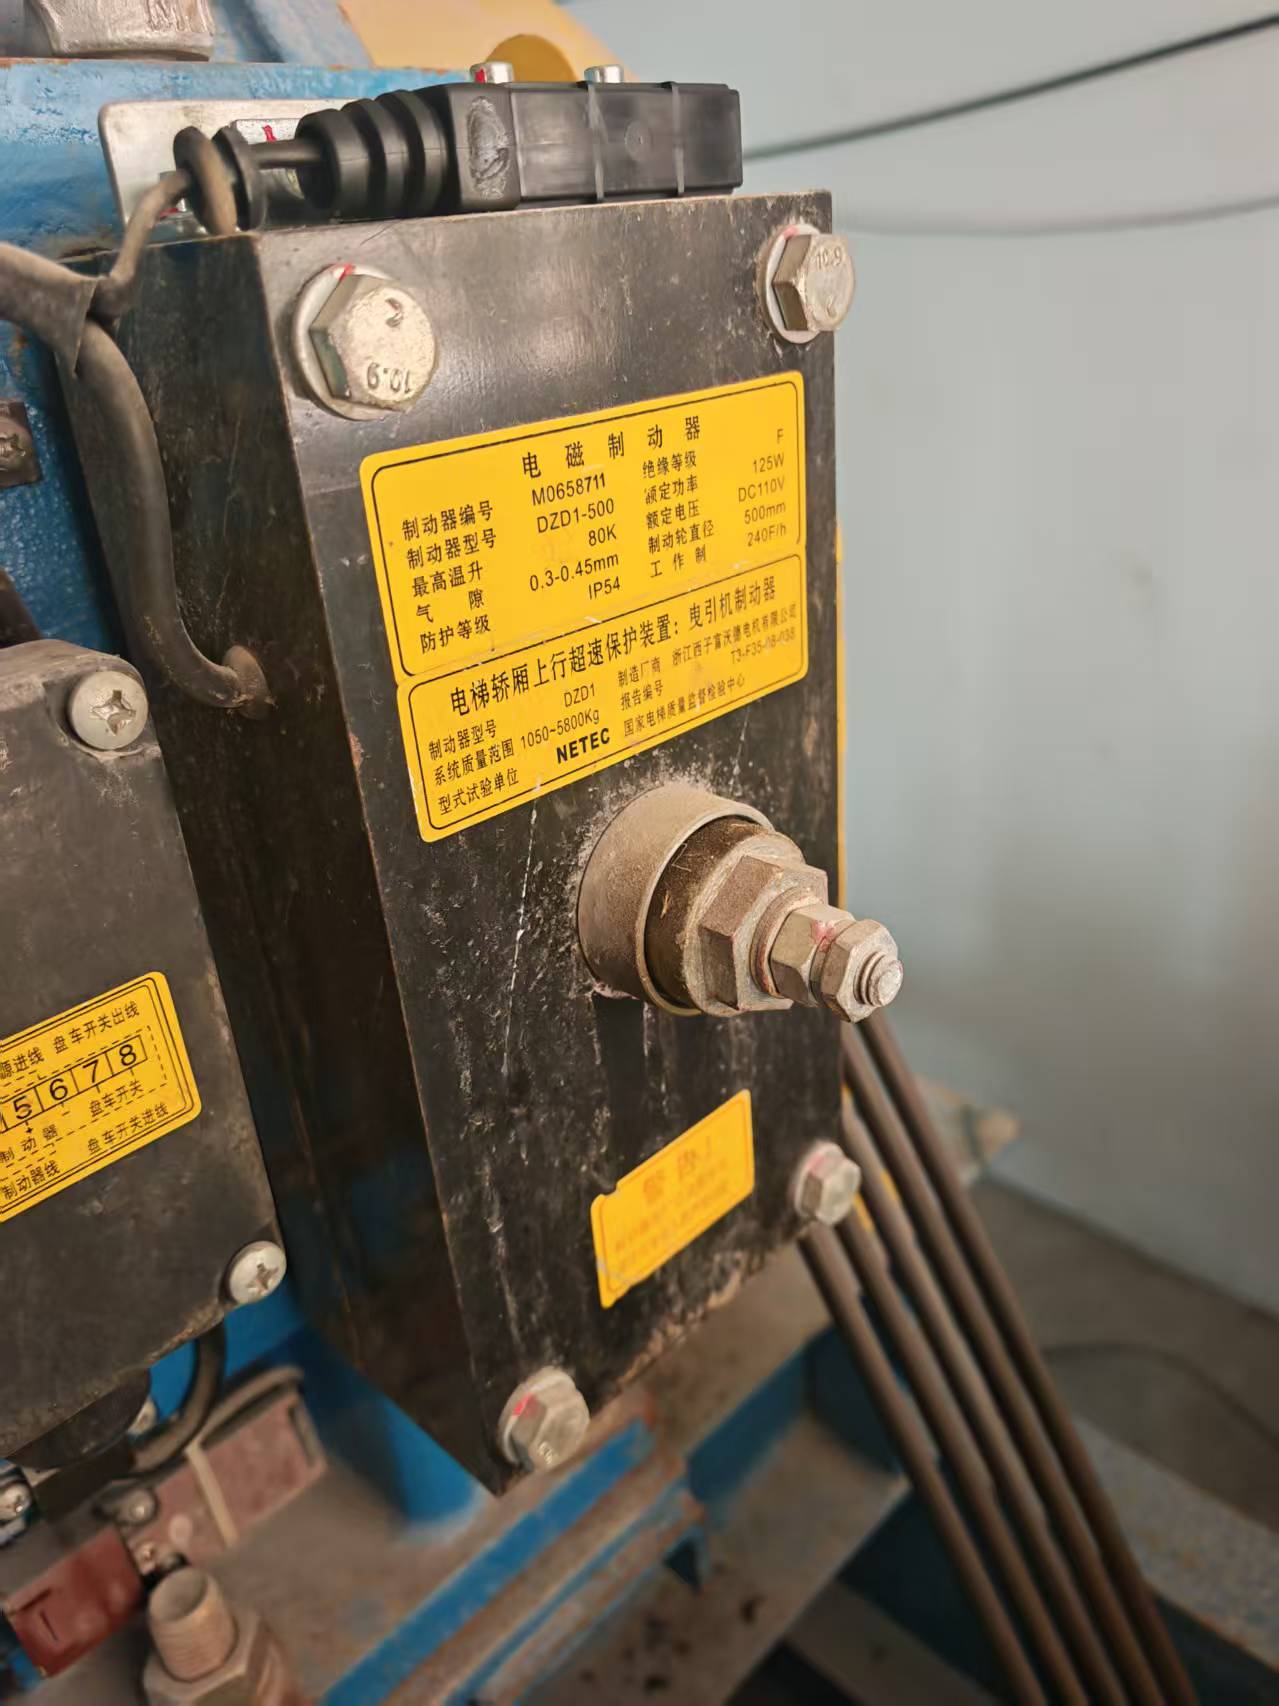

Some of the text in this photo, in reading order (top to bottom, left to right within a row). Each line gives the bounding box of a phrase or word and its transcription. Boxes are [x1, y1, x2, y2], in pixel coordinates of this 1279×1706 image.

[776, 428, 785, 444] F
[642, 450, 697, 479] 绝缘等级
[753, 452, 785, 474] 125W
[531, 472, 606, 506] M0658711
[644, 474, 698, 505] 额定功率
[738, 477, 786, 502] DC110V
[402, 500, 493, 541] 制动器编号
[537, 498, 614, 533] DZD1-500
[646, 499, 700, 530] 额定电压
[744, 502, 786, 525] 500mm
[406, 528, 496, 570] 制动器型号
[588, 524, 618, 546] 80K
[648, 520, 714, 554] 制动轮直径
[748, 523, 787, 547] 240F/h
[412, 560, 484, 598] 最高温升
[529, 554, 619, 591] 0.3-0.45mm
[588, 576, 621, 600] IP54
[420, 614, 491, 654] 防护等级
[618, 657, 661, 688] 制造厂商
[563, 683, 596, 708] DZD1
[620, 680, 664, 711] 报告编号
[428, 719, 497, 761] 制动器型号
[521, 709, 600, 750] 1050~5800Kg
[556, 727, 611, 764] NETEC
[434, 738, 515, 787] 系统质量范围
[438, 768, 519, 816] 型式试验单位
[52, 1001, 140, 1054] 盘车开关出线
[13, 1044, 137, 1119] 5 6 7 8
[89, 1080, 145, 1117] 盘车开关
[2, 1104, 169, 1201] 制动器线 盘车开关进线
